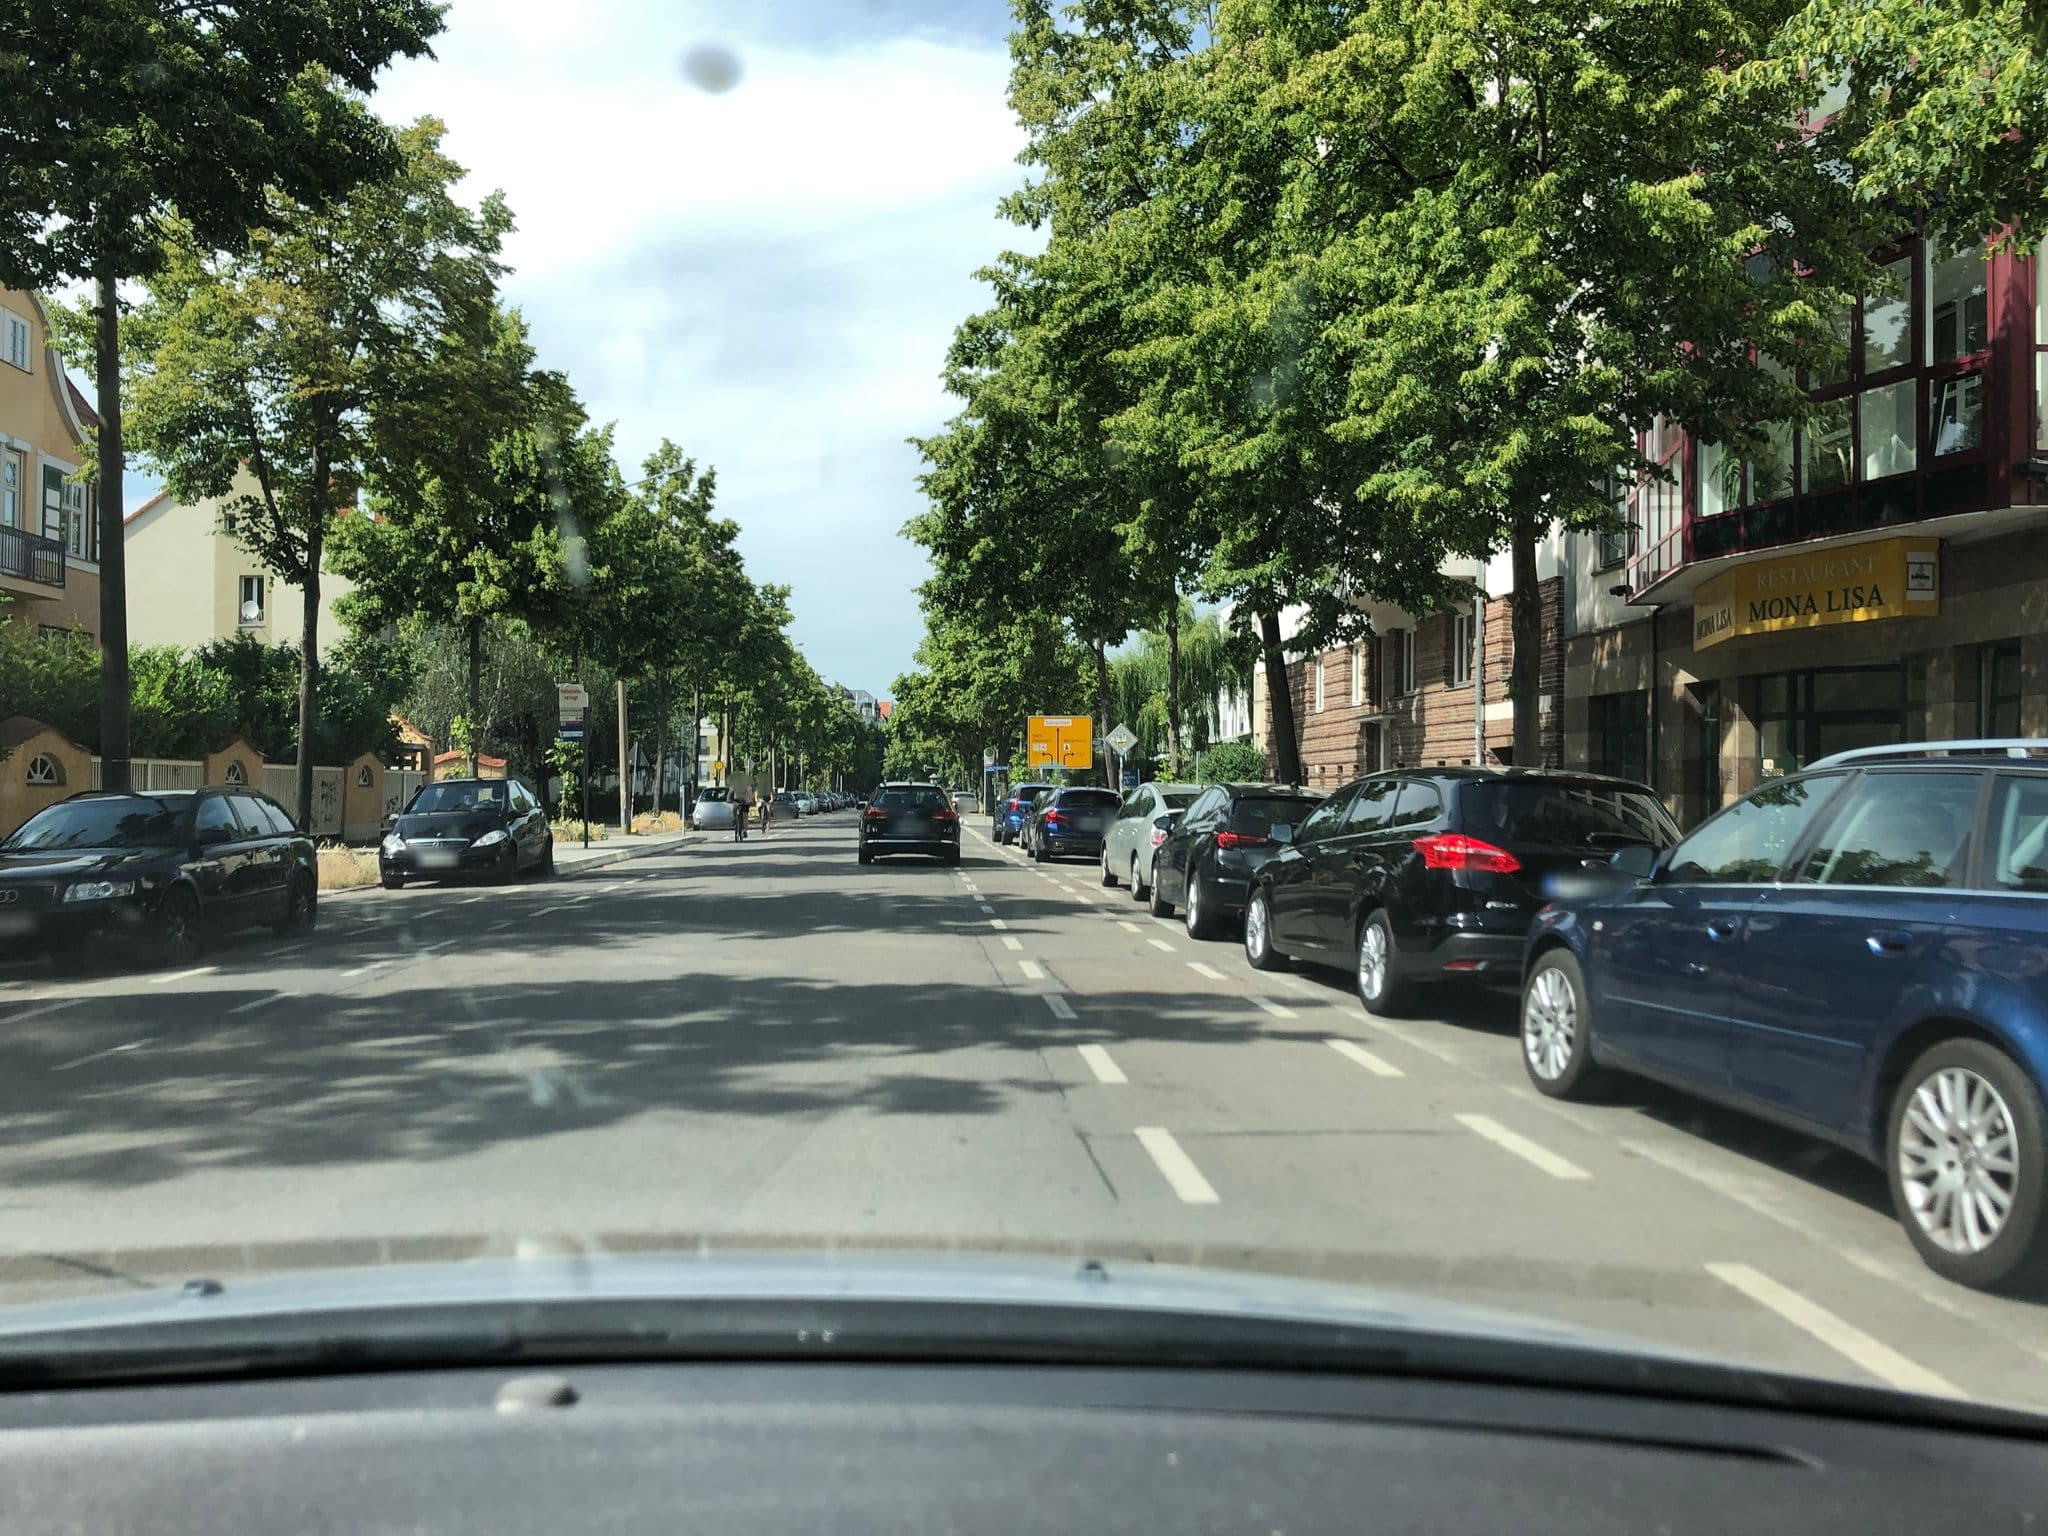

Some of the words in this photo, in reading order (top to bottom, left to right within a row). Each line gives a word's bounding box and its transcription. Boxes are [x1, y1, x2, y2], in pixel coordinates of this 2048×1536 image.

[1757, 555, 1876, 589] RESTAURANT
[1749, 593, 1818, 622] MONA
[1826, 584, 1885, 613] LISA
[1696, 615, 1715, 640] MONA
[1716, 607, 1731, 630] LISA
